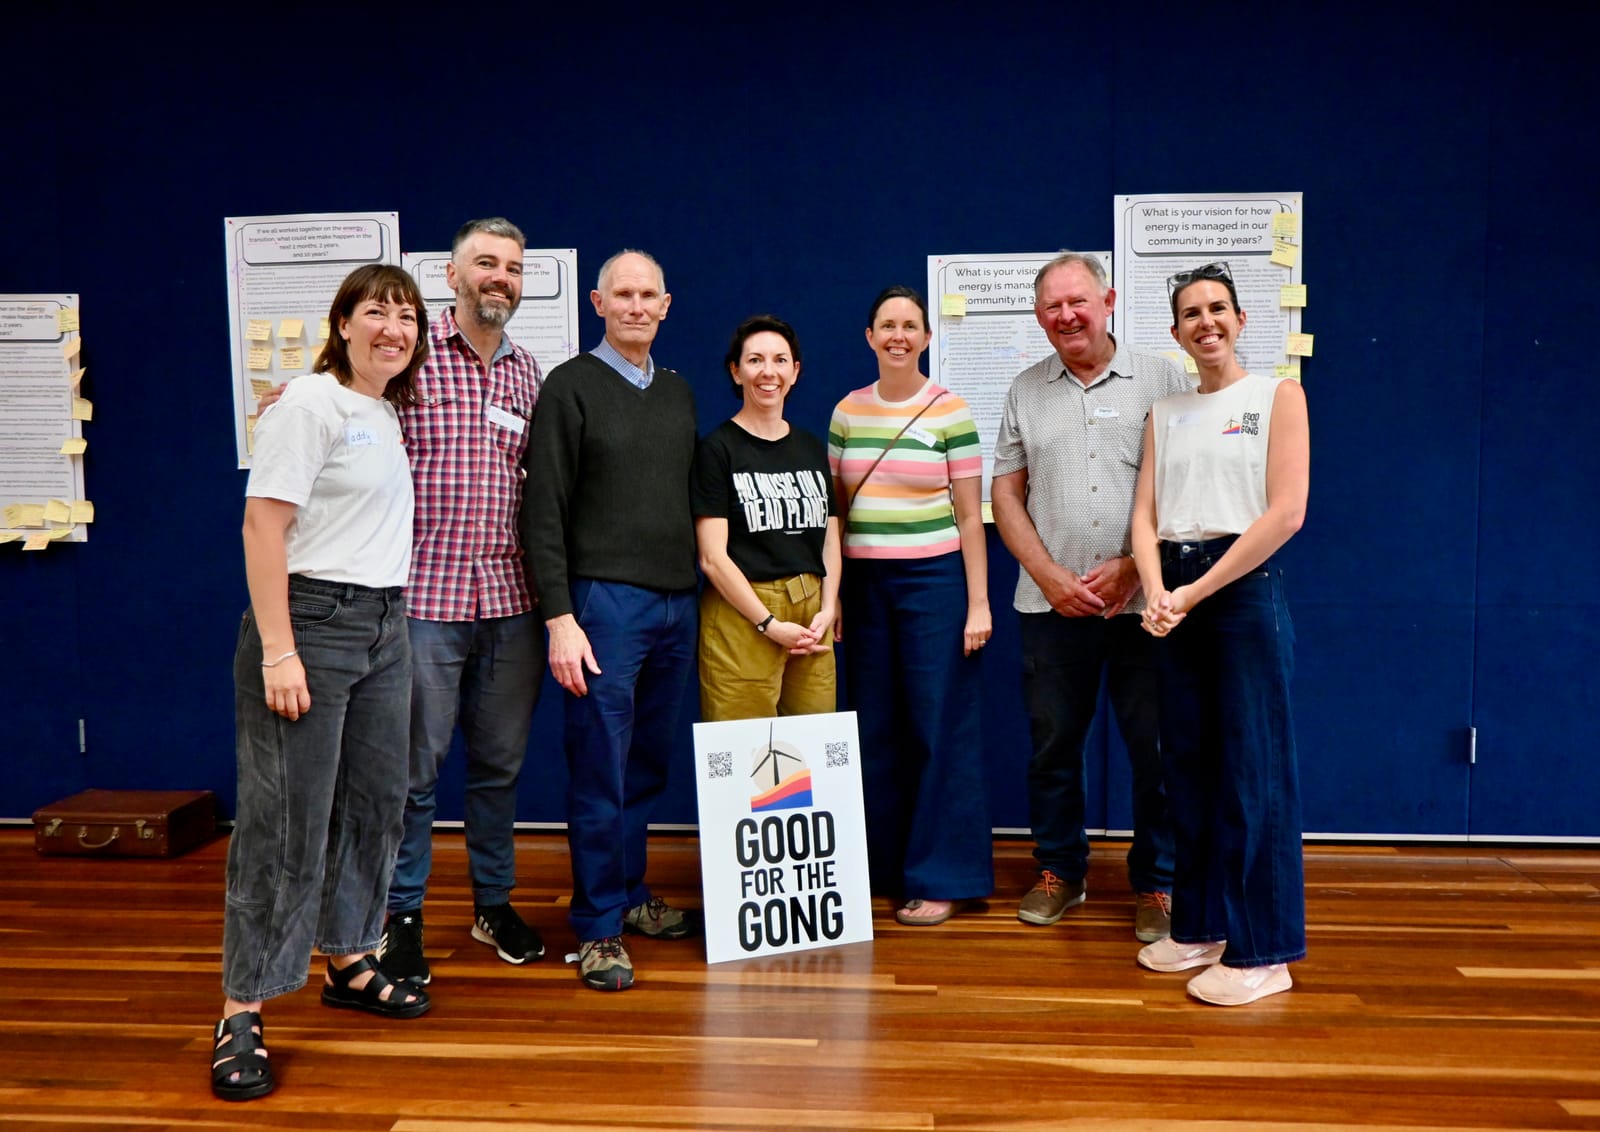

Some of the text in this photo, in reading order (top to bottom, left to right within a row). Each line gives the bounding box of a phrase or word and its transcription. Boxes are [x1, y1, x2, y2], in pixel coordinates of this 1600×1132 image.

[1142, 206, 1271, 218] What is your vision for how
[1144, 223, 1180, 232] energy
[1182, 222, 1190, 230] is
[1192, 221, 1238, 232] managed
[1240, 221, 1249, 230] in
[1148, 236, 1262, 247] community in 30 years?
[955, 269, 980, 277] What
[994, 269, 1014, 278] your
[958, 284, 992, 292] energy
[1004, 282, 1036, 291] manag
[1242, 412, 1260, 420] GOOD
[1241, 426, 1259, 436] GONG
[733, 473, 758, 504] NO
[754, 472, 801, 499] MUSIC
[796, 470, 822, 498] ON
[744, 499, 784, 532] DEAD
[735, 810, 836, 868] GOOD
[740, 860, 836, 898] FOR THE
[738, 891, 844, 952] GONG
